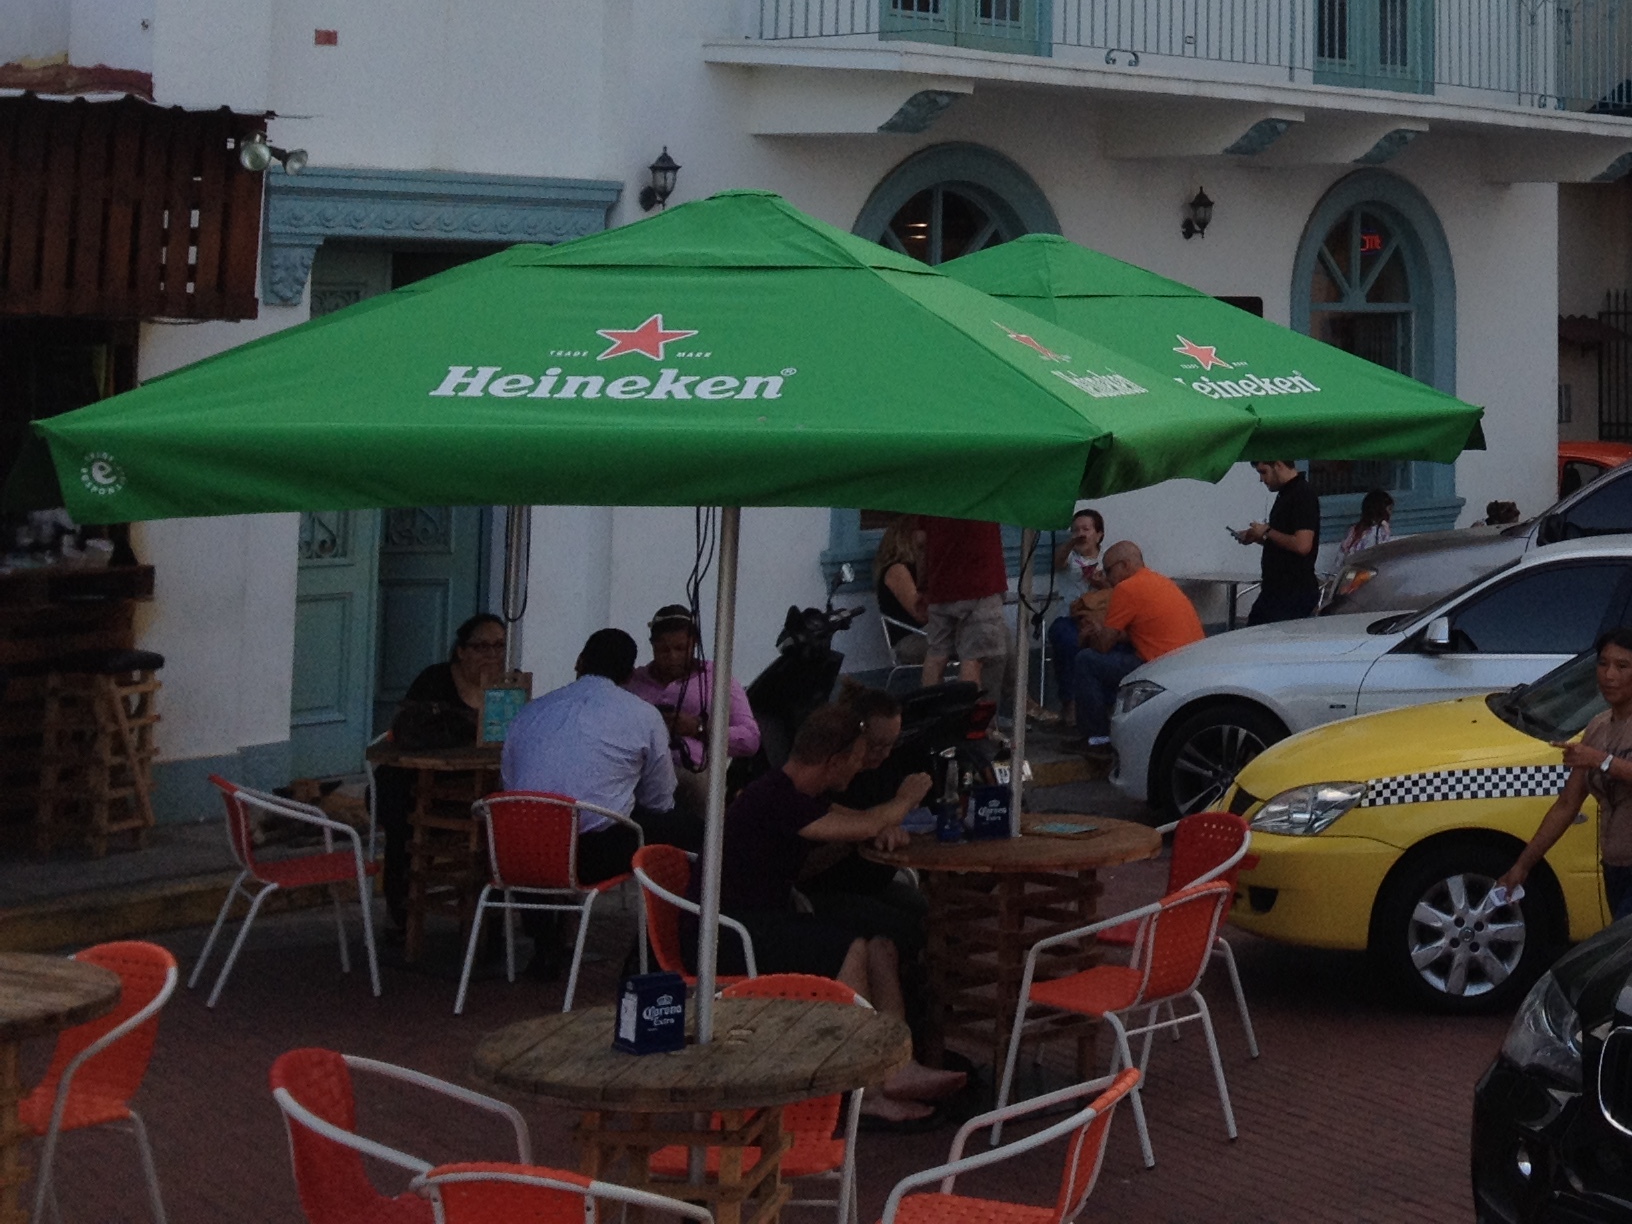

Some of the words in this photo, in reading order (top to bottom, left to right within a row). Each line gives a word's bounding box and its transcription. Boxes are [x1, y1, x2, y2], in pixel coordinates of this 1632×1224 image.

[429, 366, 785, 399] Heineken
[1173, 374, 1321, 399] eineken
[643, 1005, 682, 1021] Corona
